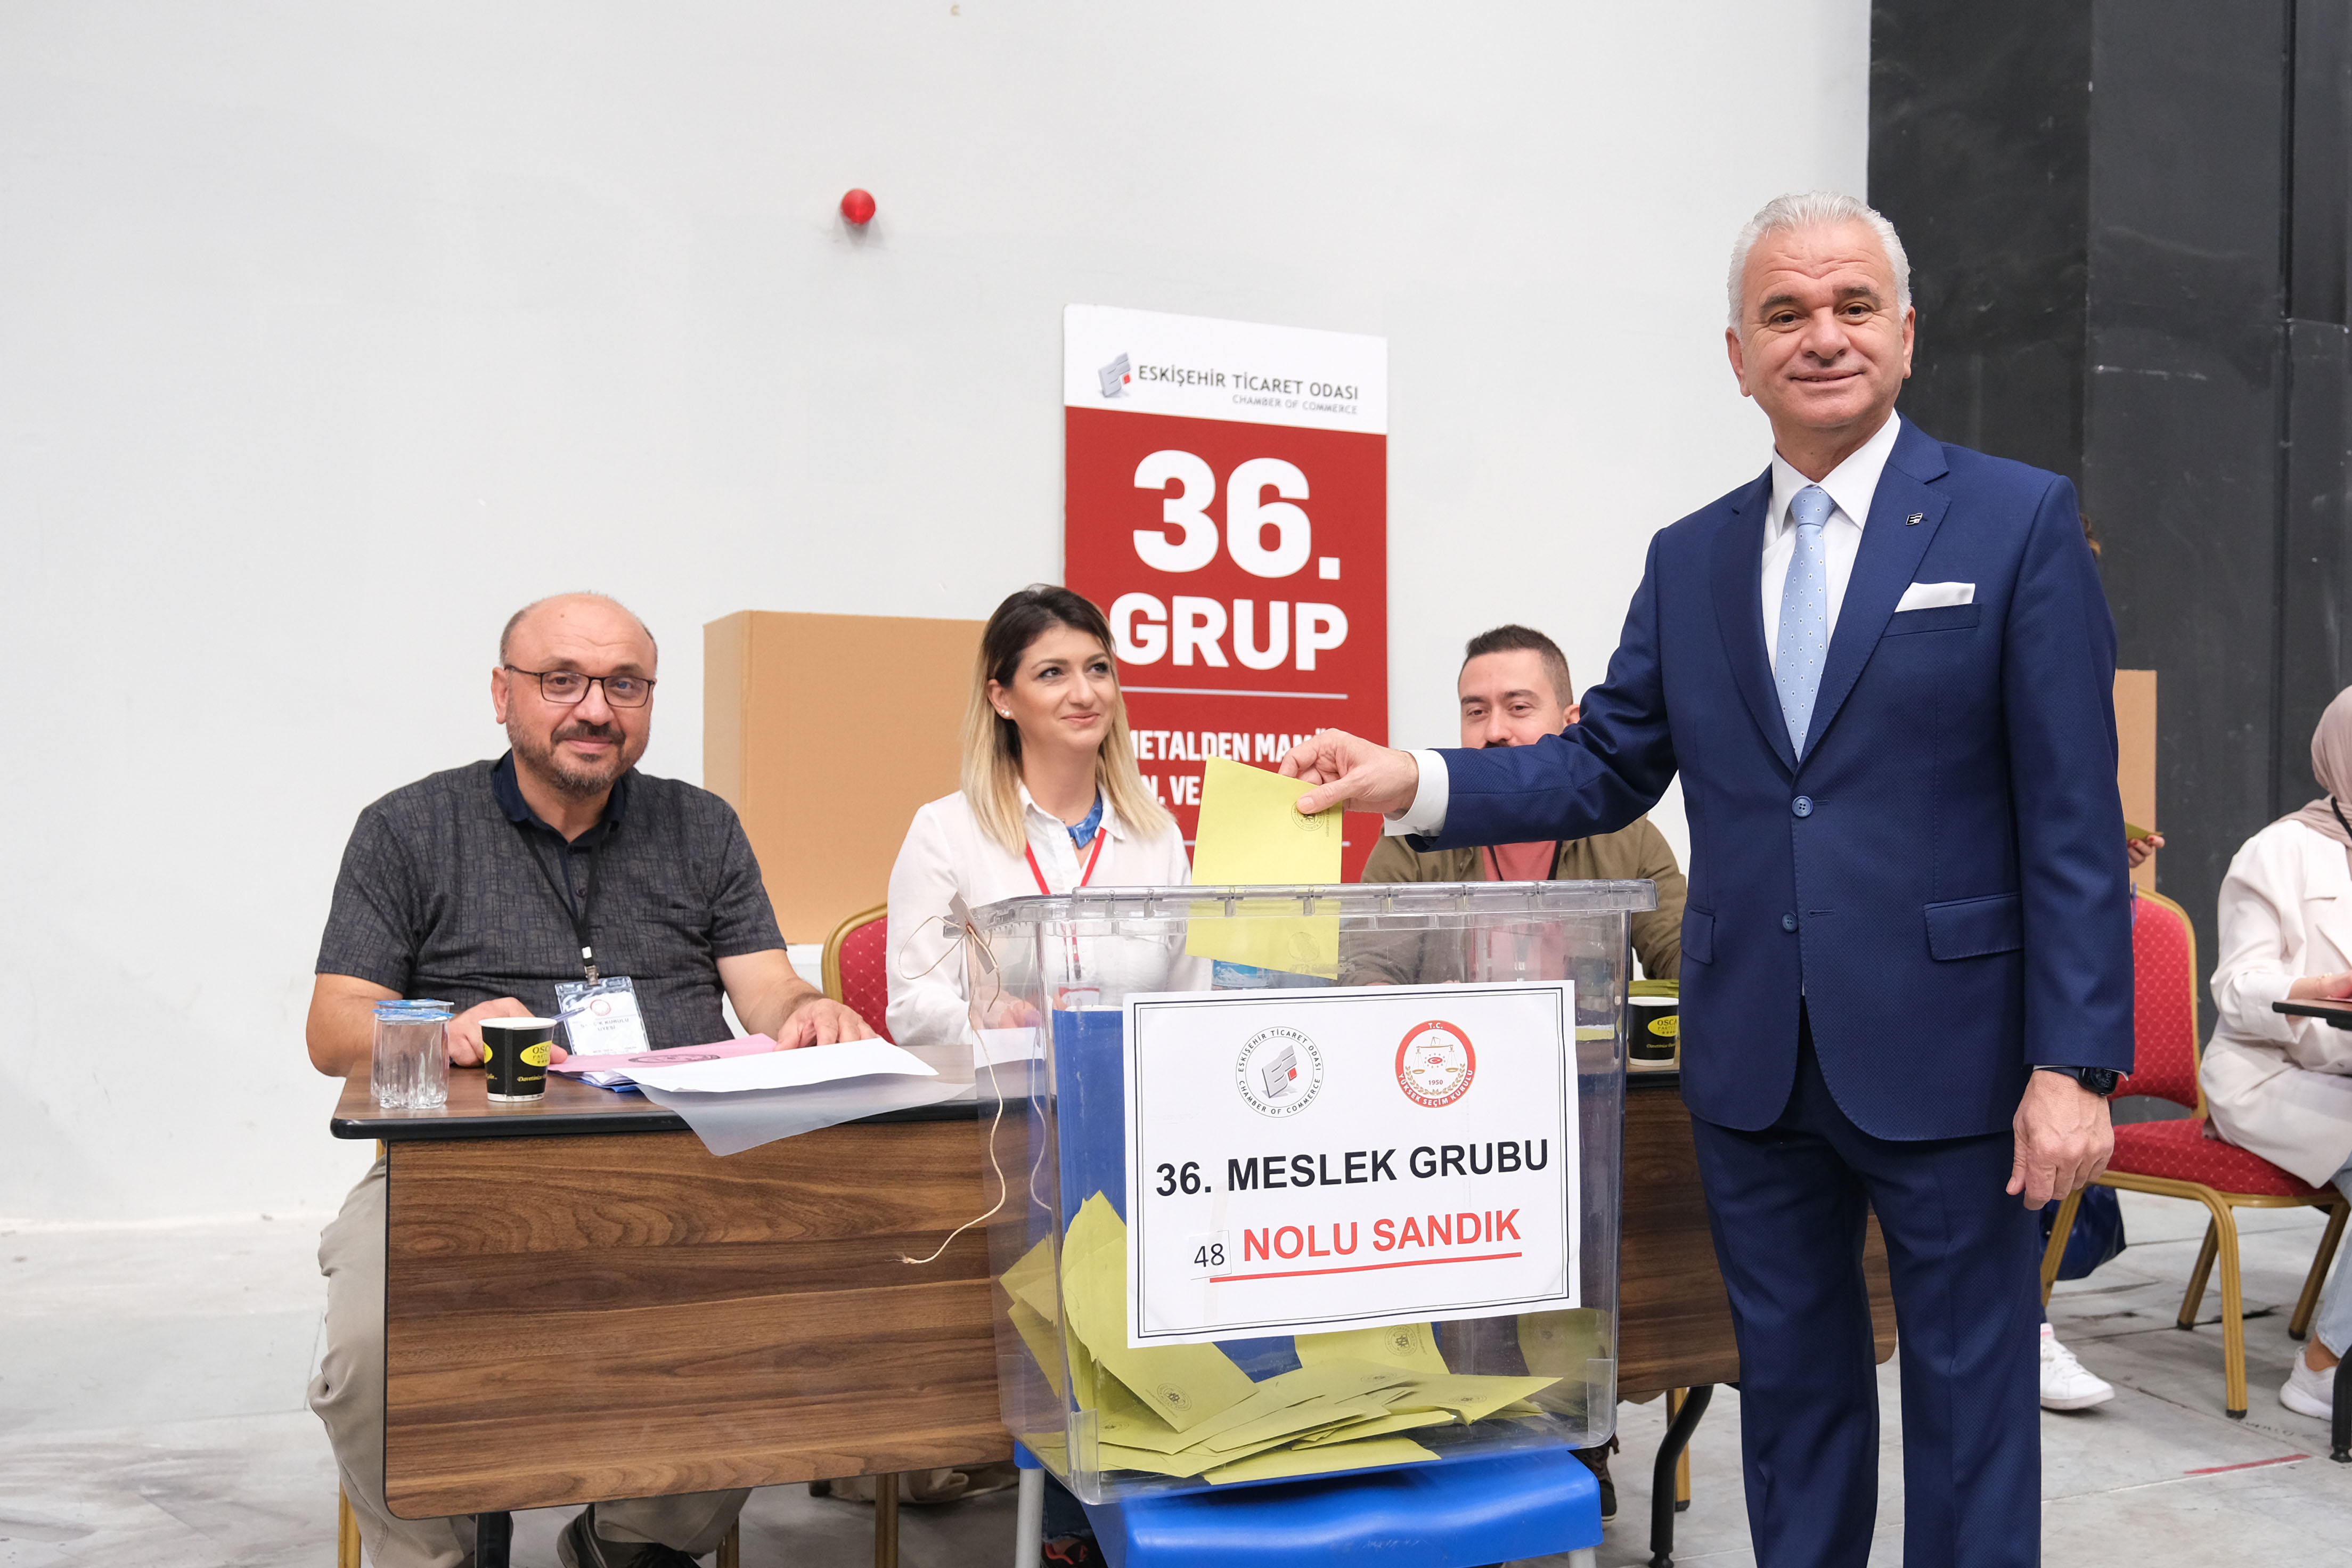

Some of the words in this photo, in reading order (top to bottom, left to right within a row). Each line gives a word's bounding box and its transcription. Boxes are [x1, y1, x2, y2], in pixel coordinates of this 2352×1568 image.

[1139, 365, 1226, 387] ESKİŞEHİR
[1232, 373, 1303, 395] TİCARET
[1309, 382, 1358, 400] ODASI
[1232, 395, 1281, 408] CHAMBER
[1284, 399, 1299, 409] OF
[1302, 401, 1358, 415] COMMERCE
[1133, 450, 1340, 580] 36.
[1109, 592, 1349, 671] GRUP
[1169, 775, 1201, 805] VE
[1238, 1033, 1267, 1072] ESKİŞEHİR
[1270, 1028, 1308, 1043] TİCARET
[1308, 1046, 1321, 1071] ODASI
[1239, 1080, 1267, 1112] CHAMBER
[1286, 1079, 1320, 1113] COMMERCE
[1398, 1073, 1422, 1102] YÜKSEK
[1423, 1098, 1449, 1107] SEÇİM
[1449, 1069, 1474, 1101] KURULU
[1156, 1162, 1212, 1197] 36.
[1228, 1149, 1397, 1191] MESLEK
[1410, 1139, 1548, 1179] GRUBU
[1194, 1243, 1225, 1268] 48
[1244, 1222, 1358, 1262] NOLU
[1373, 1208, 1522, 1251] SANDIK
